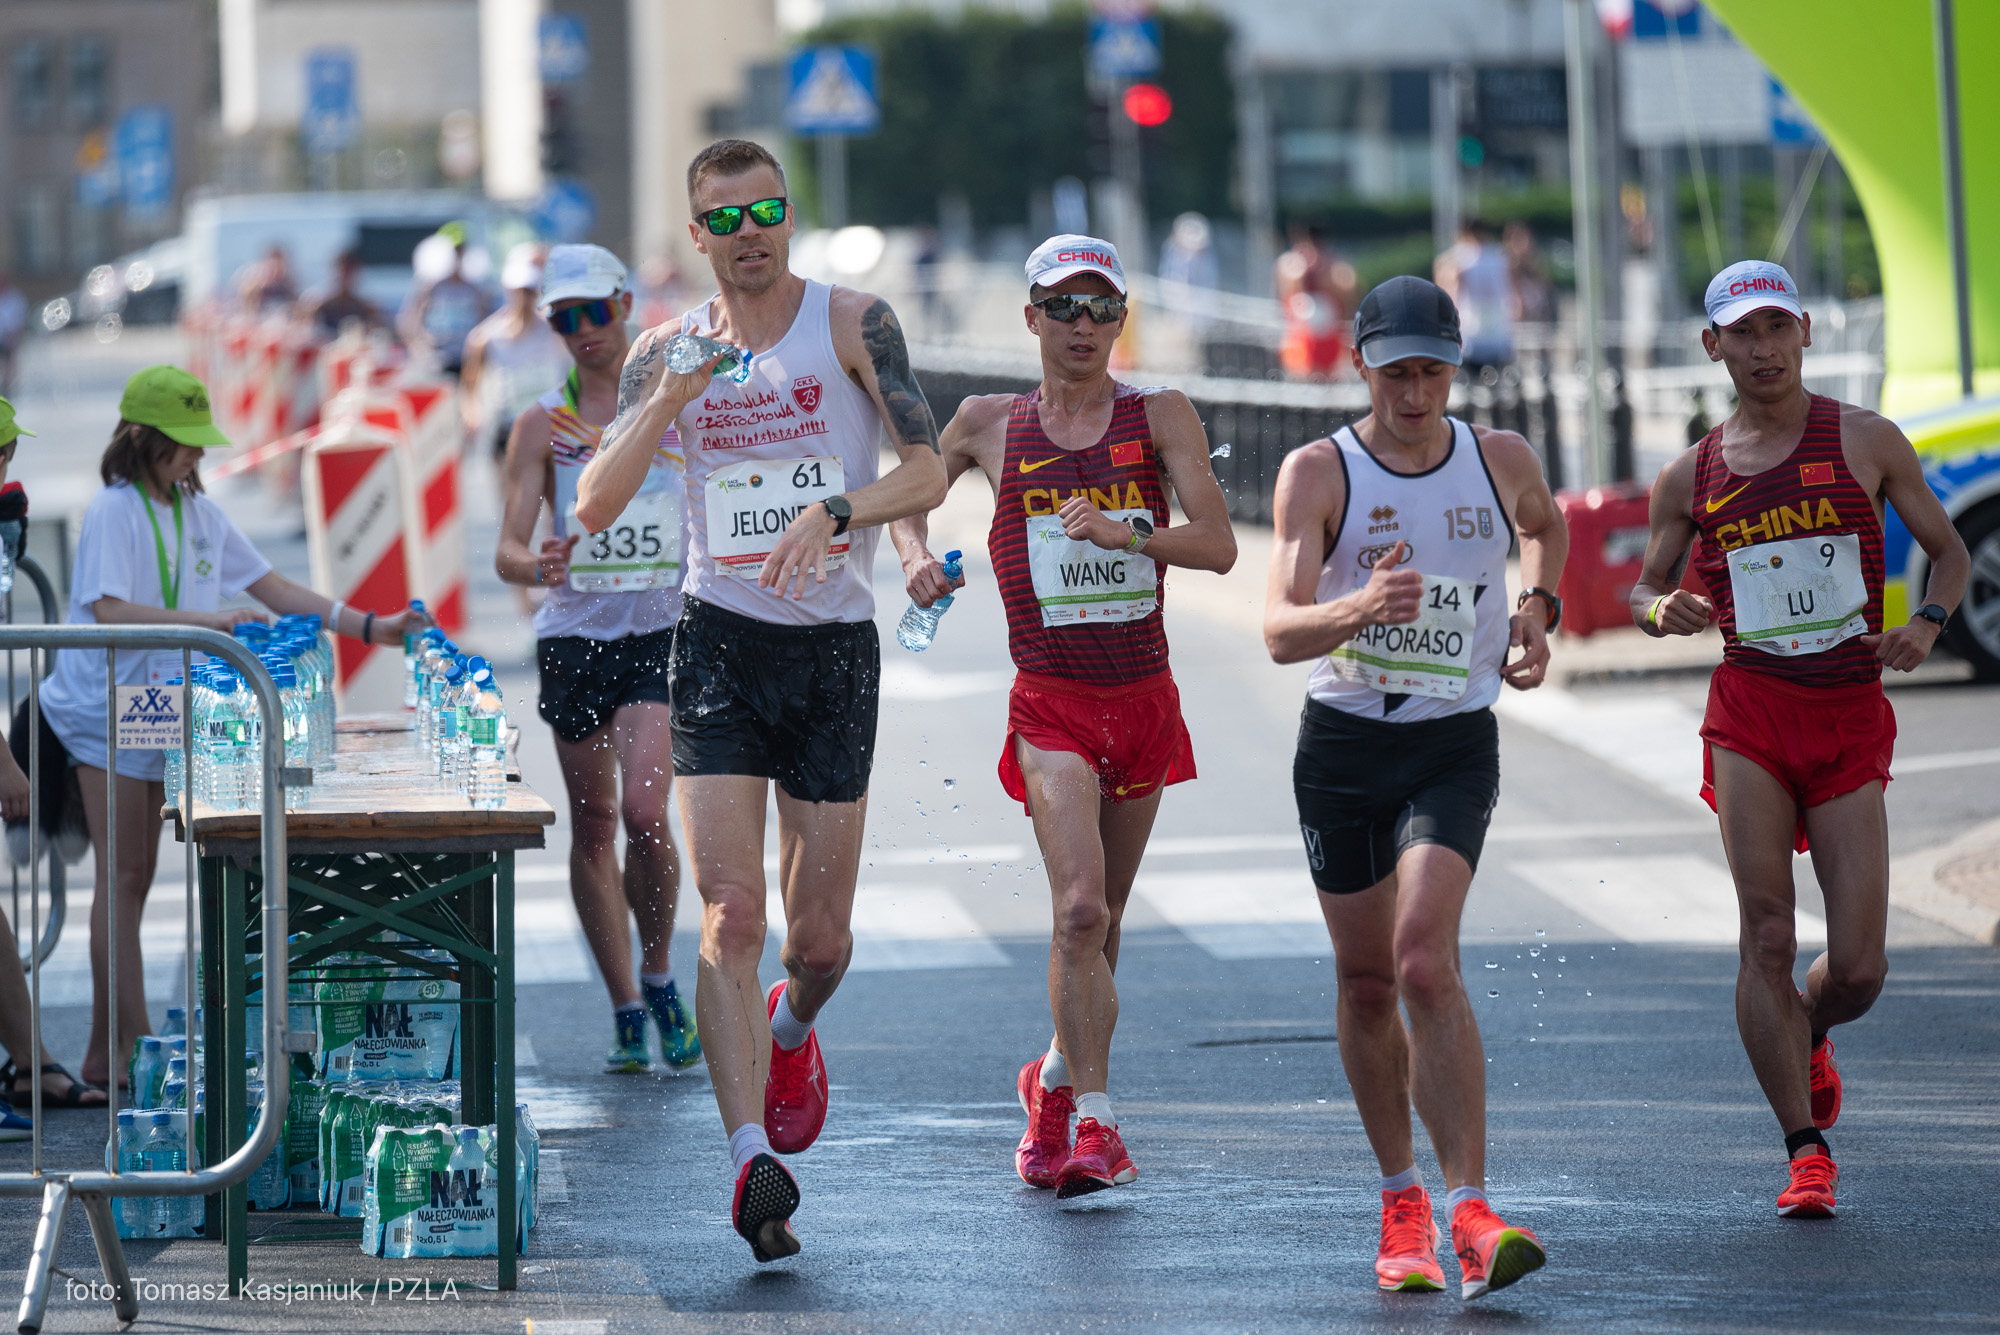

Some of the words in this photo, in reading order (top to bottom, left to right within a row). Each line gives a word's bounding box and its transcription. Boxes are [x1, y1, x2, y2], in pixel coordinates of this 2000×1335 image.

[1057, 251, 1113, 270] CHINA
[1729, 277, 1787, 297] CHINA
[796, 379, 814, 387] CKS
[792, 462, 827, 489] 61
[730, 505, 811, 538] JELON
[1715, 497, 1842, 551] CHINA
[590, 526, 661, 561] 335
[1819, 542, 1836, 568] 9
[1059, 560, 1126, 588] WANG
[1428, 584, 1462, 612] 14
[1787, 590, 1815, 617] LU
[1349, 624, 1464, 658] APORASO
[119, 726, 182, 735] www.armex5.pl
[119, 737, 132, 745] 22
[134, 737, 151, 745] 761
[154, 737, 167, 745] 06
[169, 737, 182, 745] 70
[354, 1038, 427, 1051] NAŁĘCZOWIANKA
[430, 1168, 483, 1209] NAŁ
[417, 1208, 496, 1223] NAŁĘCZOWIANKA
